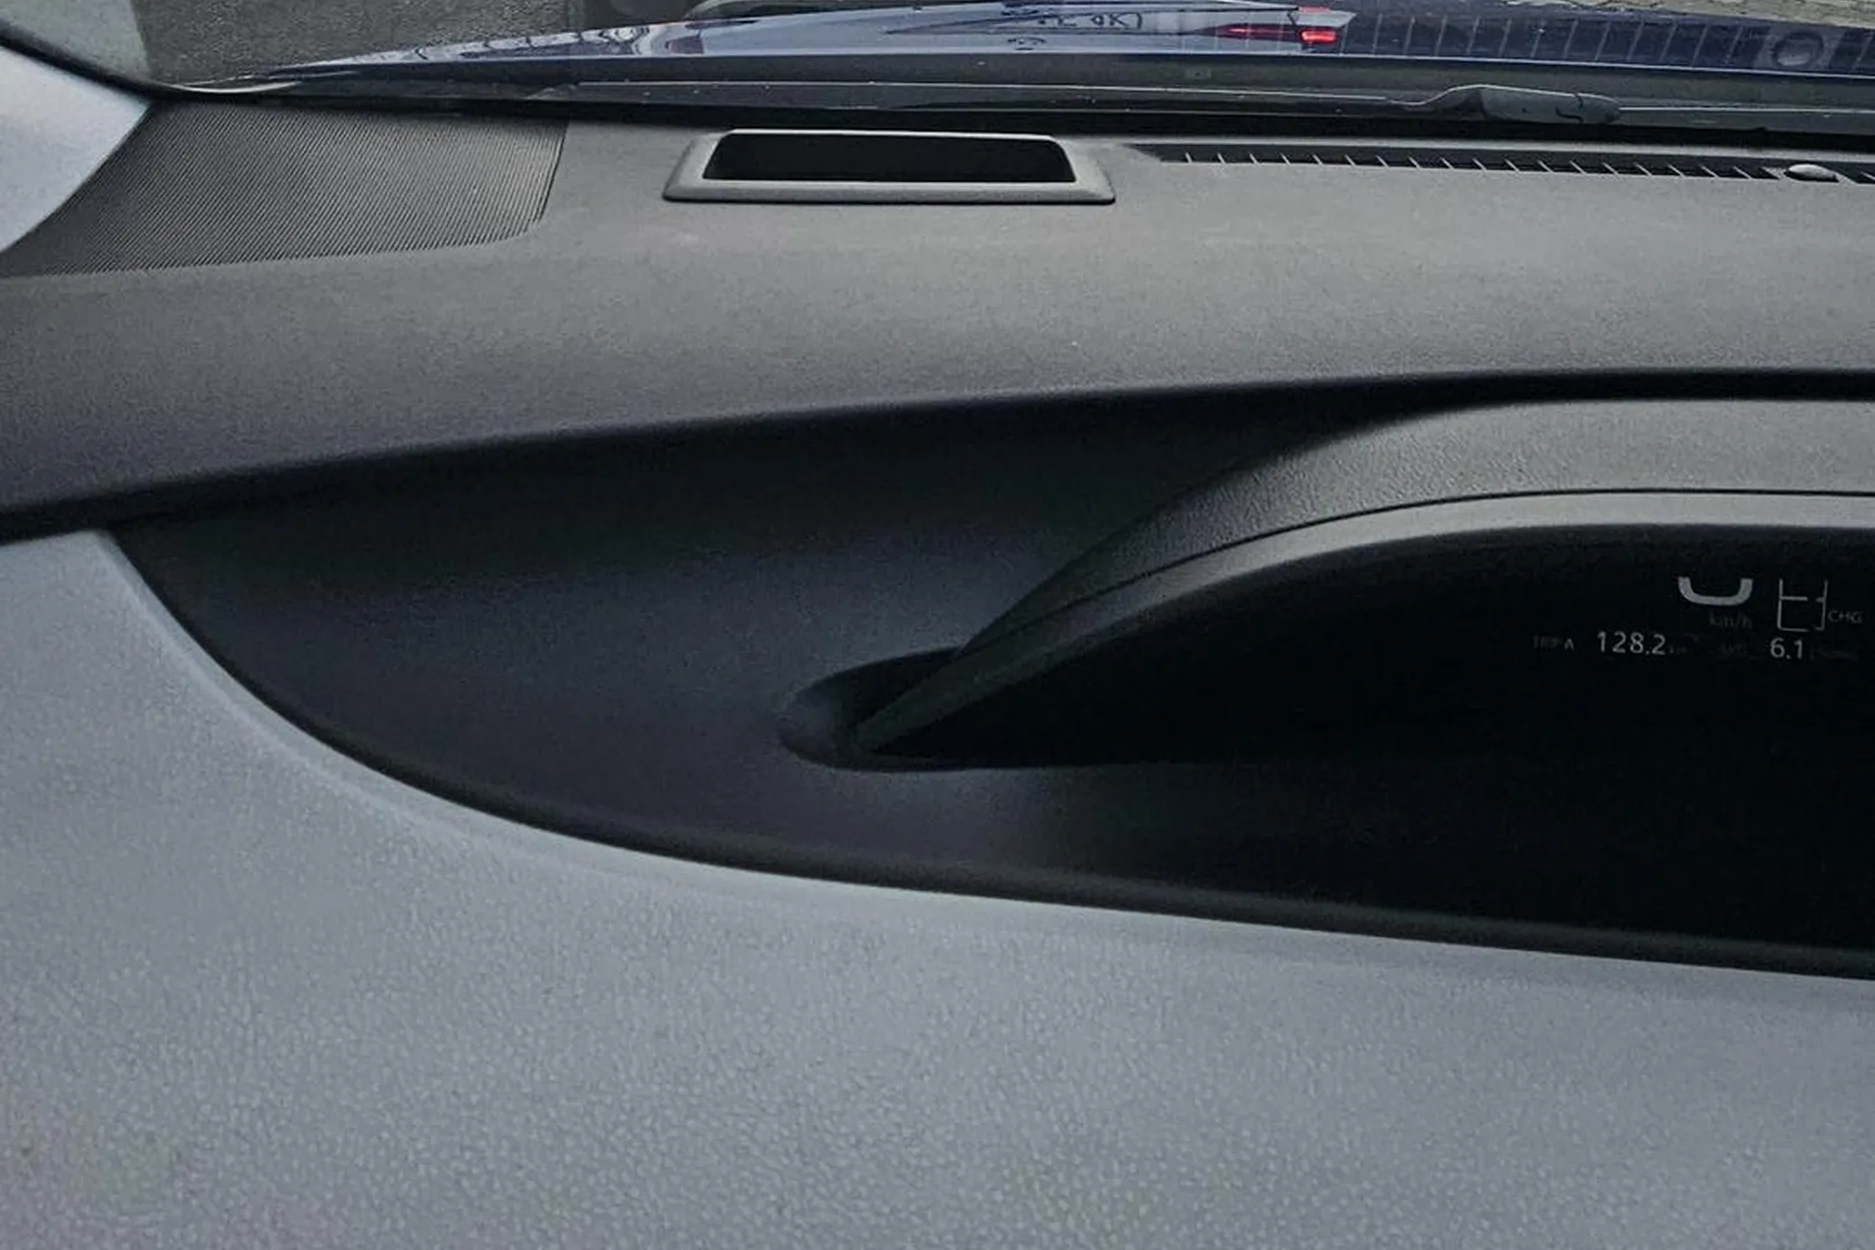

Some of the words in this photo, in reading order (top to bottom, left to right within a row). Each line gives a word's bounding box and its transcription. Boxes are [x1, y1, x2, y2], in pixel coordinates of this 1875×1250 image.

[1827, 609, 1865, 625] CHG
[1596, 629, 1667, 656] 128.2
[1768, 636, 1804, 661] 6.1
